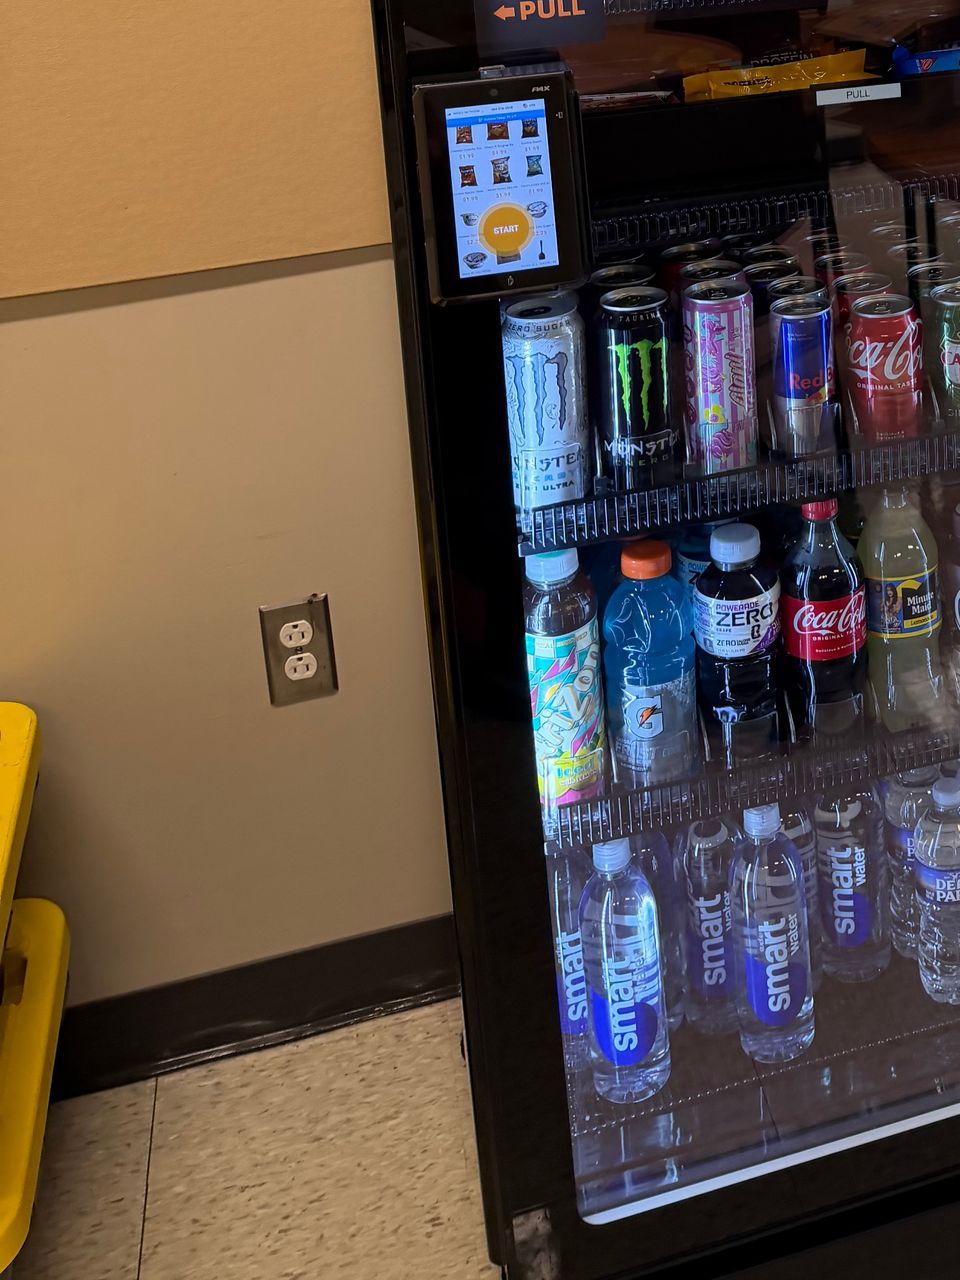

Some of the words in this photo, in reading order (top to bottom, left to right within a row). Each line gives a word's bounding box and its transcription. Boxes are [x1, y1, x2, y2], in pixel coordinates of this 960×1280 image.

[846, 89, 871, 100] PULL
[493, 224, 519, 234] START
[507, 322, 530, 333] ZERO
[536, 320, 572, 332] SUGAR
[789, 368, 824, 390] Red
[857, 382, 894, 391] ORIGINAL
[543, 481, 575, 491] ULTRA
[716, 600, 760, 612] POWERADE
[716, 602, 773, 627] ZERO
[716, 636, 737, 647] ZERO
[813, 634, 844, 642] ORIGINAL
[827, 847, 856, 935] smart
[855, 846, 866, 887] water
[695, 893, 727, 985] smart
[758, 918, 790, 1012] smart
[787, 913, 798, 955] water
[556, 931, 588, 1021] smart
[607, 957, 638, 1052] smart
